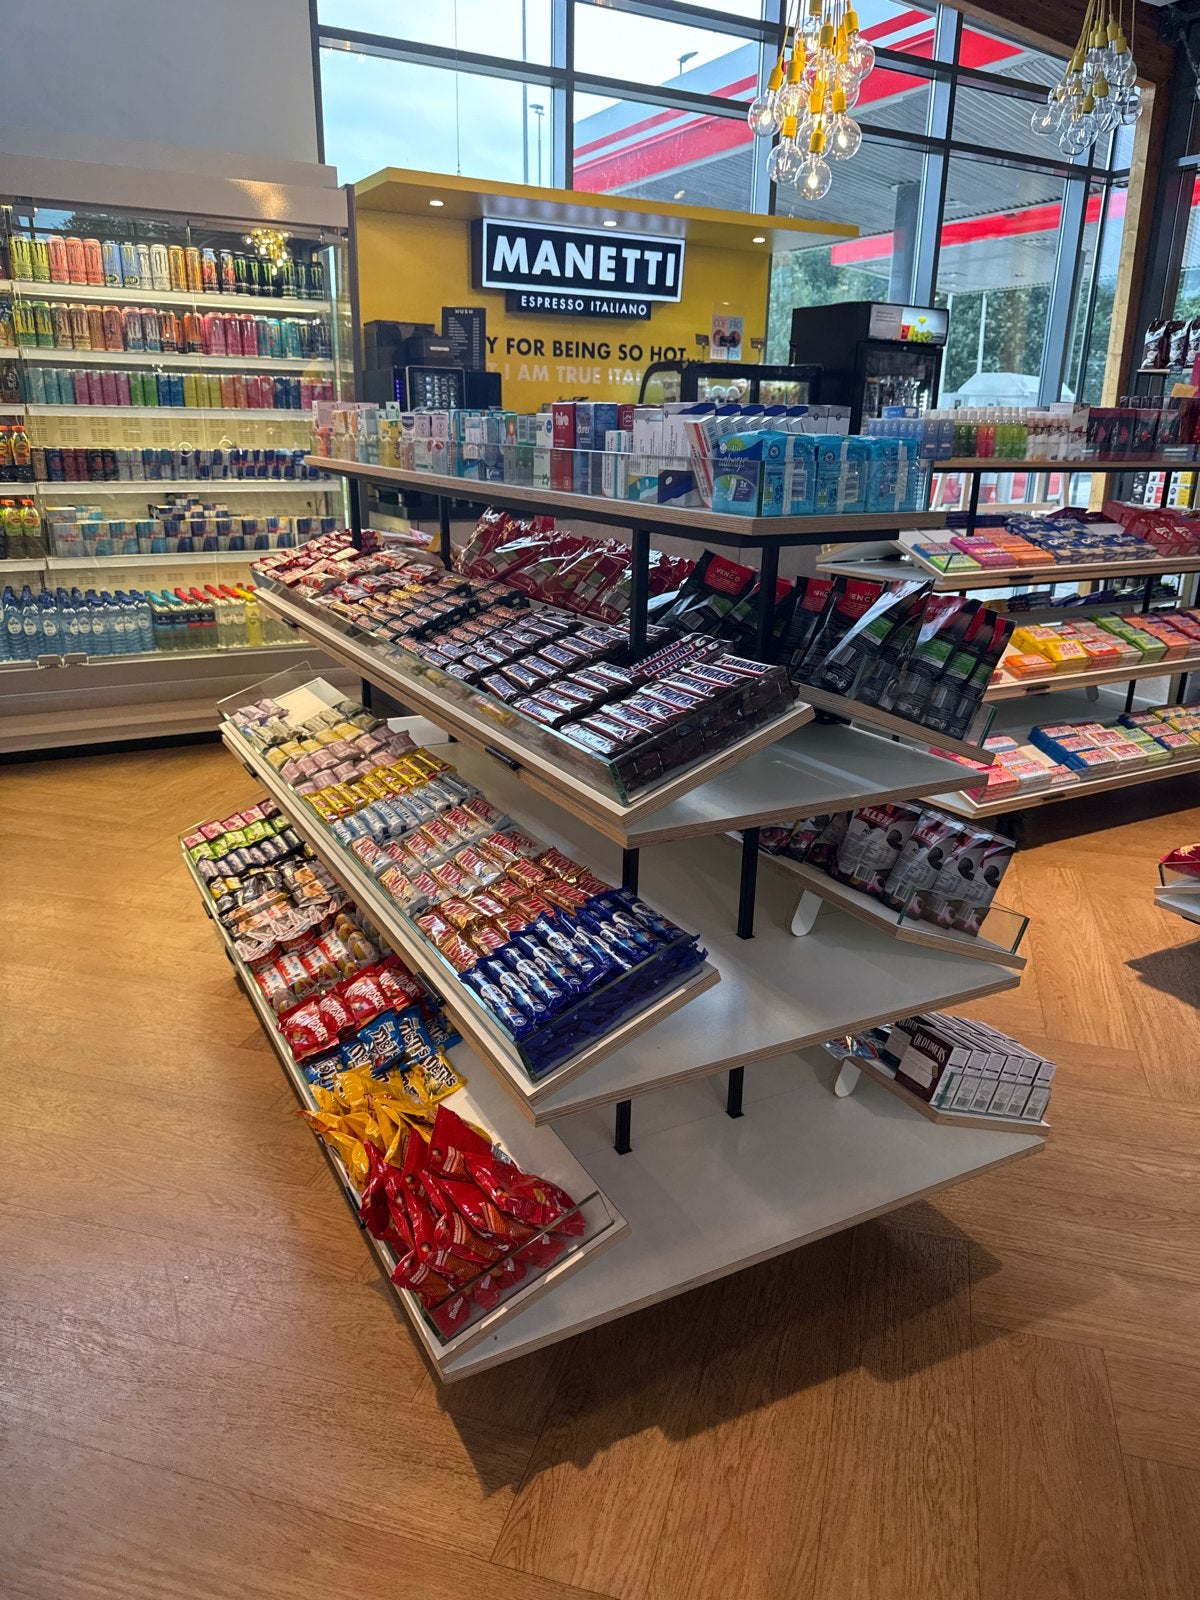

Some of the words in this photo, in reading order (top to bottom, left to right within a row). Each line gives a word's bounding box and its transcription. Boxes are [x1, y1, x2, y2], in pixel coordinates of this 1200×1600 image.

[492, 235, 676, 287] MANETTI
[521, 295, 584, 312] ESPRESSO
[591, 300, 648, 316] ITALIANO
[506, 337, 545, 357] FOR
[552, 340, 611, 360] BEING
[618, 344, 643, 361] SO
[517, 363, 549, 383] AM
[556, 365, 601, 385] TRUE
[715, 567, 741, 583] VENCO
[643, 643, 693, 677] SNICKERS
[444, 806, 472, 828] TWIX
[466, 797, 494, 819] TWIX
[423, 818, 451, 840] TWIX
[386, 841, 410, 864] TWIX
[404, 831, 432, 854] TWIX
[490, 831, 518, 852] TWIX
[399, 862, 411, 874] Xtra
[437, 861, 464, 886] TWIX
[414, 872, 441, 897] TWIX
[456, 884, 469, 895] Xtra
[344, 978, 386, 1010] Maltesers
[285, 1009, 329, 1042] Maltesers
[913, 1033, 948, 1064] OLDTIMERS
